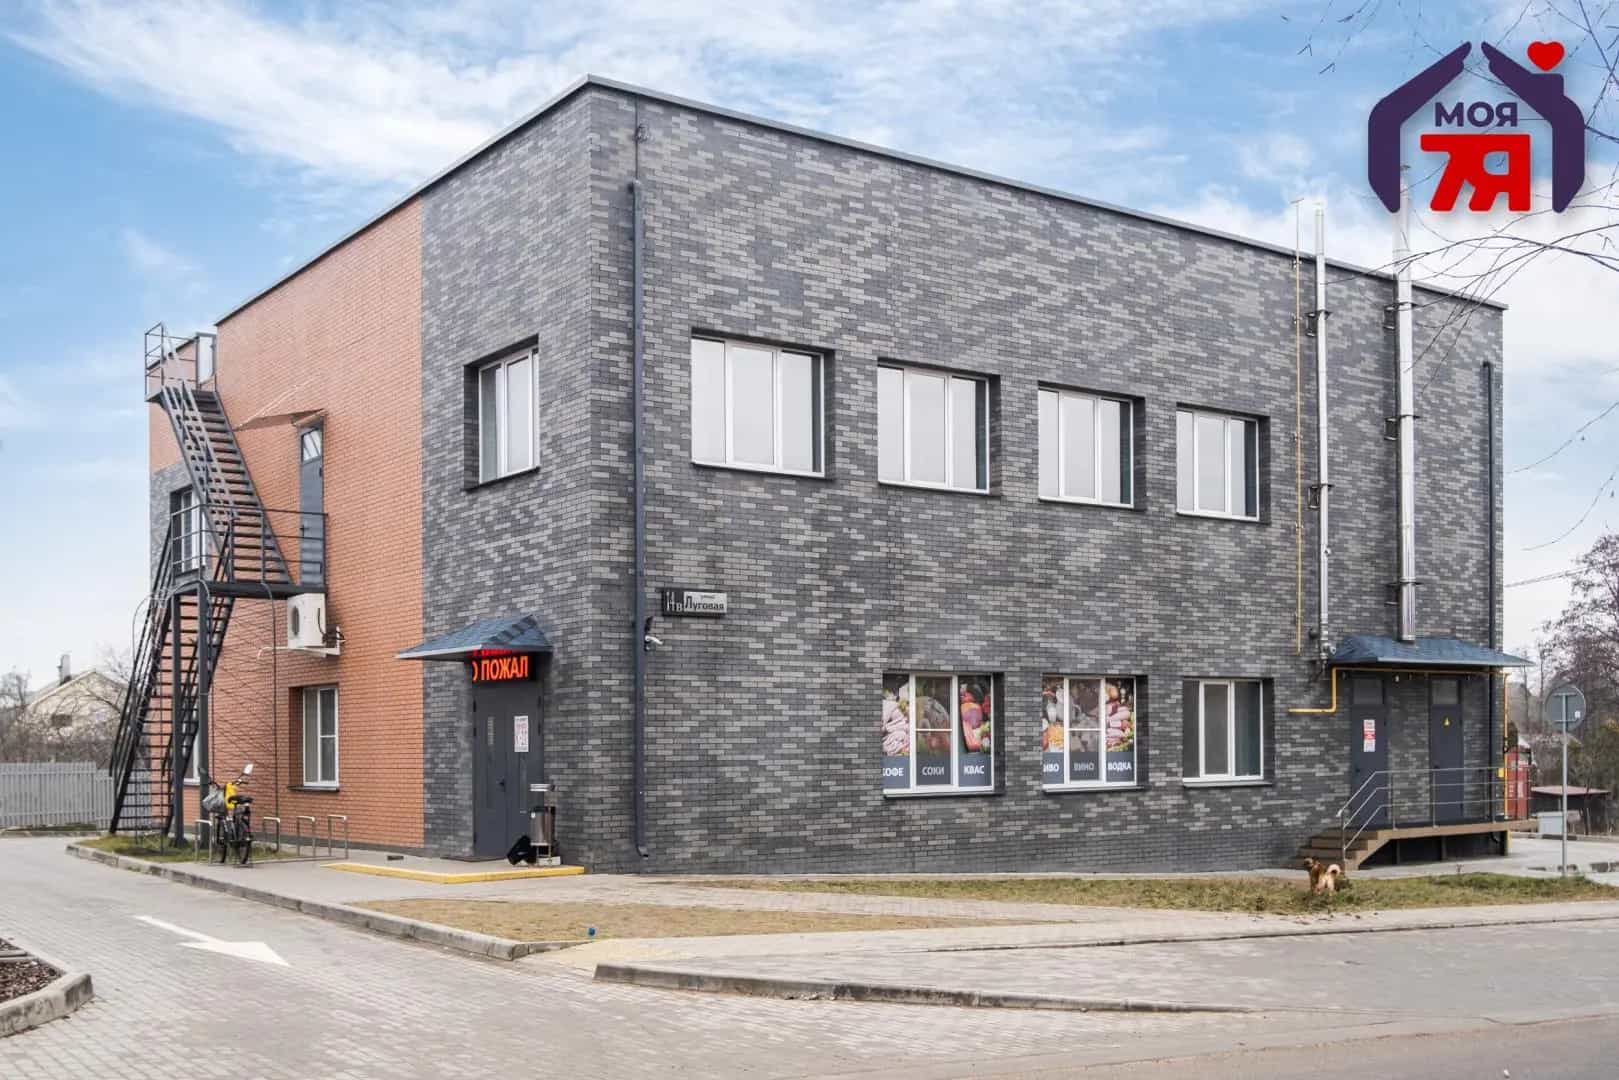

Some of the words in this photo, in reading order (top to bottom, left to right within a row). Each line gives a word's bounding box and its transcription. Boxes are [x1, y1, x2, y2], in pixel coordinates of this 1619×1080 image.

[685, 595, 724, 611] Луговая
[481, 656, 528, 681] ПОЖАЛ
[922, 766, 945, 776] СОКИ
[964, 765, 985, 775] КВАС
[1073, 762, 1094, 771] ВИНО
[1107, 761, 1132, 773] ВОДКА
